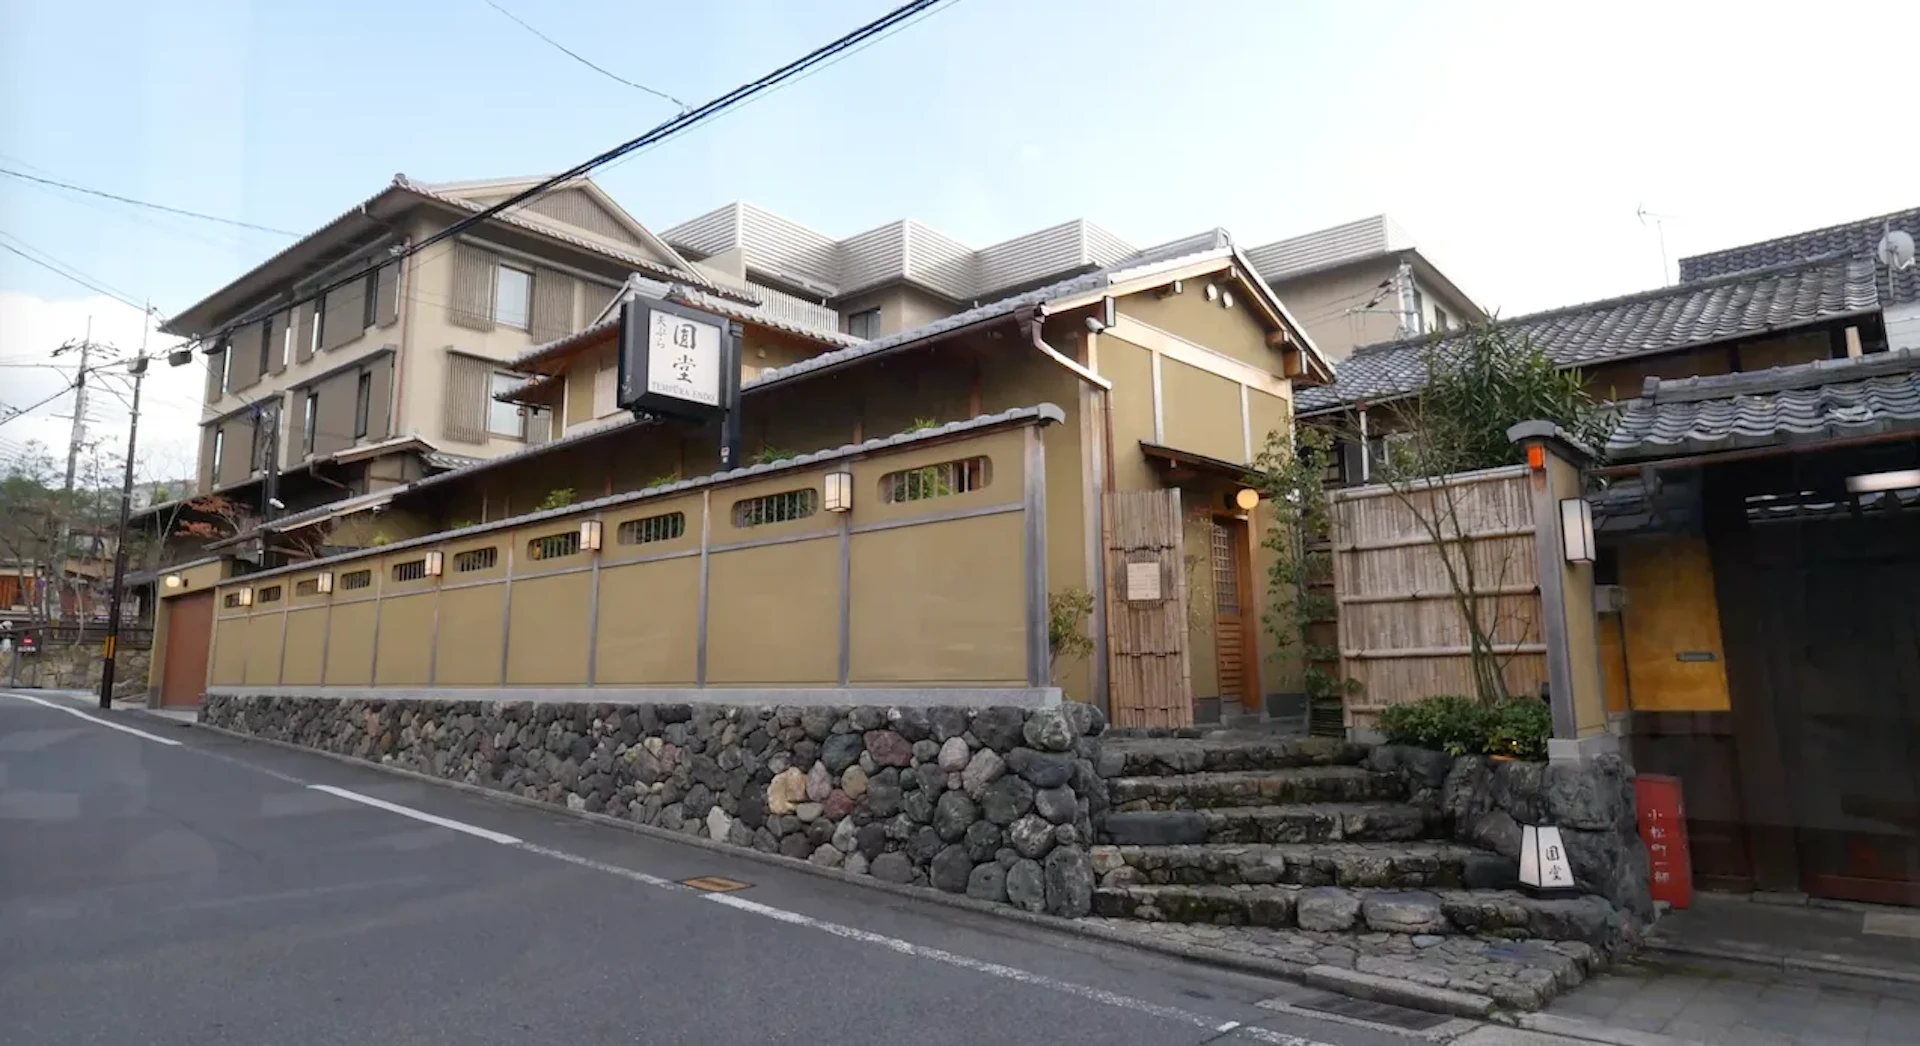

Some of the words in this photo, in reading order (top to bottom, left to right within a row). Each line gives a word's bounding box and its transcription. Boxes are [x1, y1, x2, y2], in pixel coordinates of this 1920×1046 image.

[656, 315, 667, 349] 天ぷら
[672, 323, 697, 384] 圓堂
